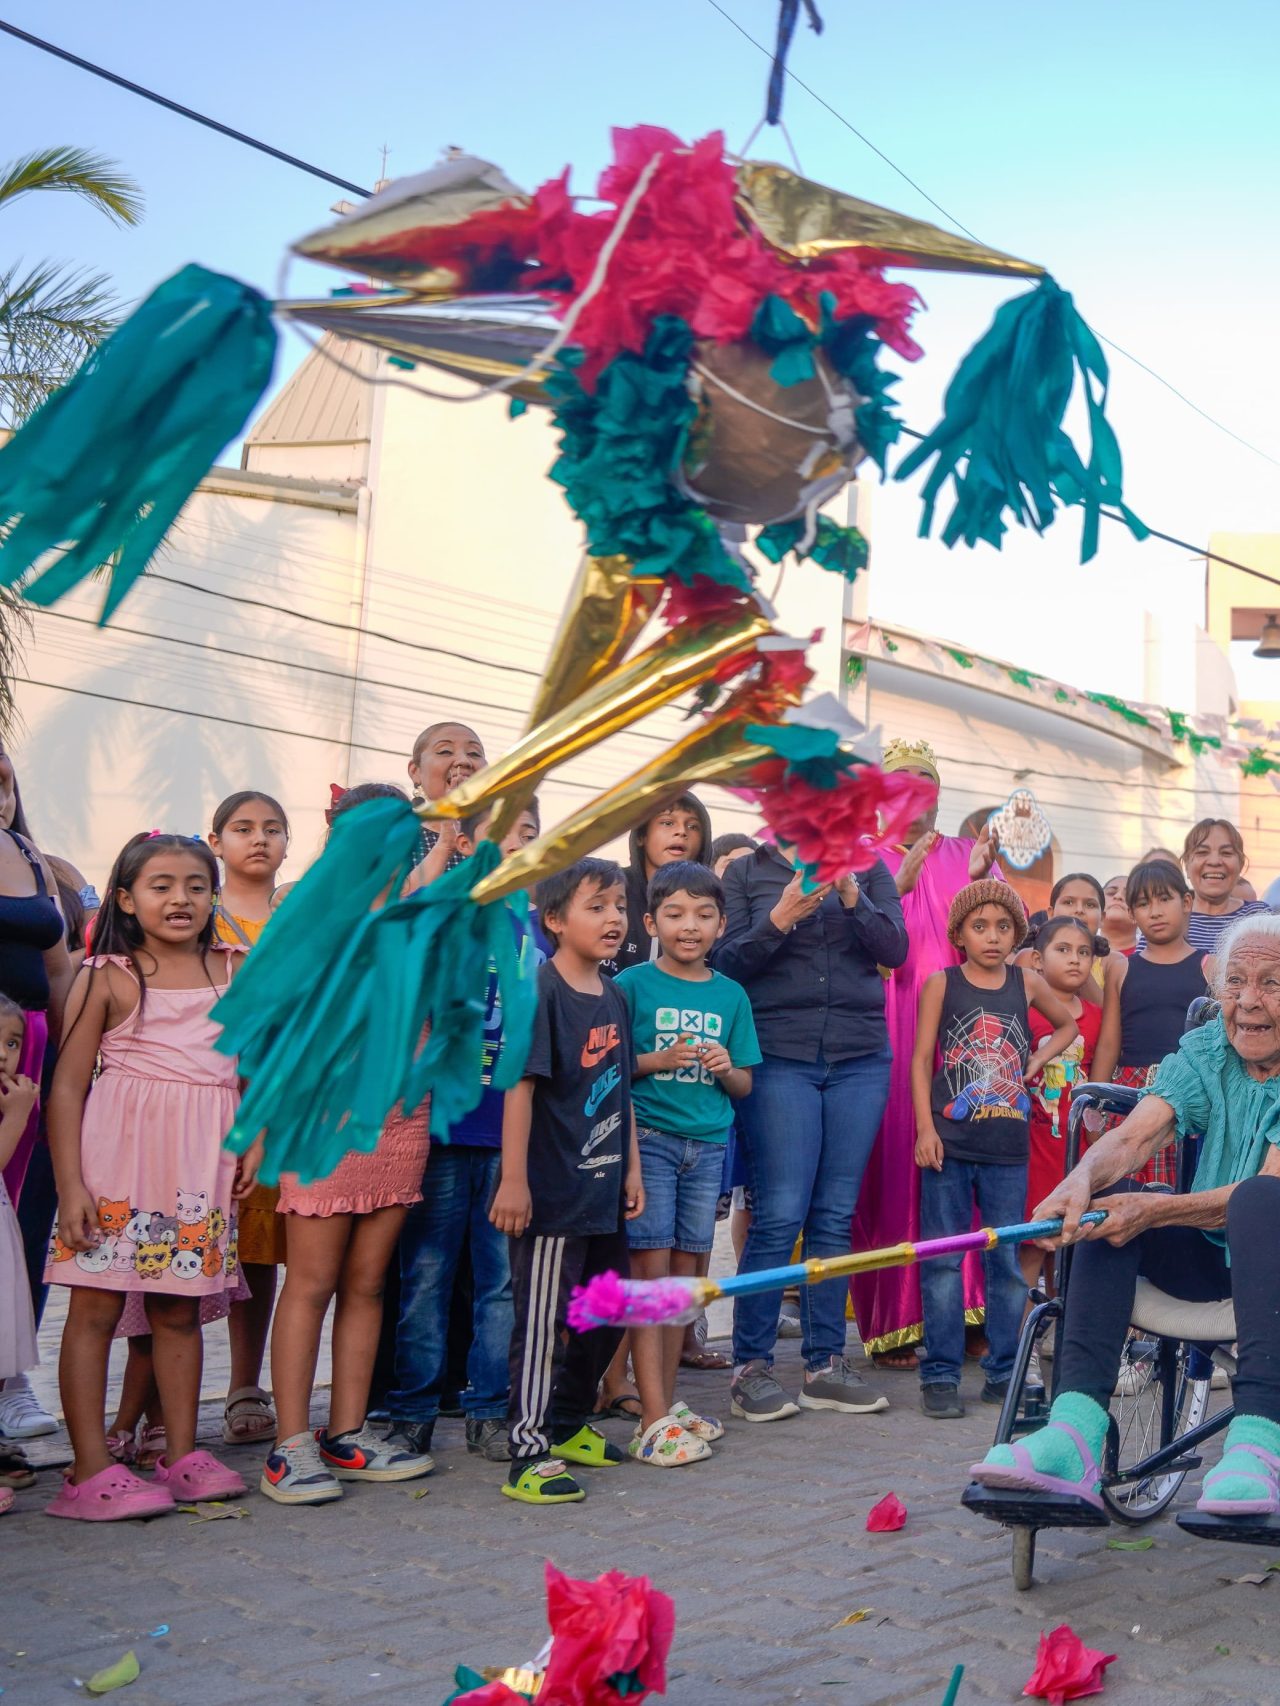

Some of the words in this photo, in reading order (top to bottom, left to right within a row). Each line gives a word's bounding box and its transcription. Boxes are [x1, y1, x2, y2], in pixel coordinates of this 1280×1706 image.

[587, 1024, 617, 1050] NIKE
[588, 1111, 621, 1147] NIKE
[593, 1170, 606, 1179] Air
